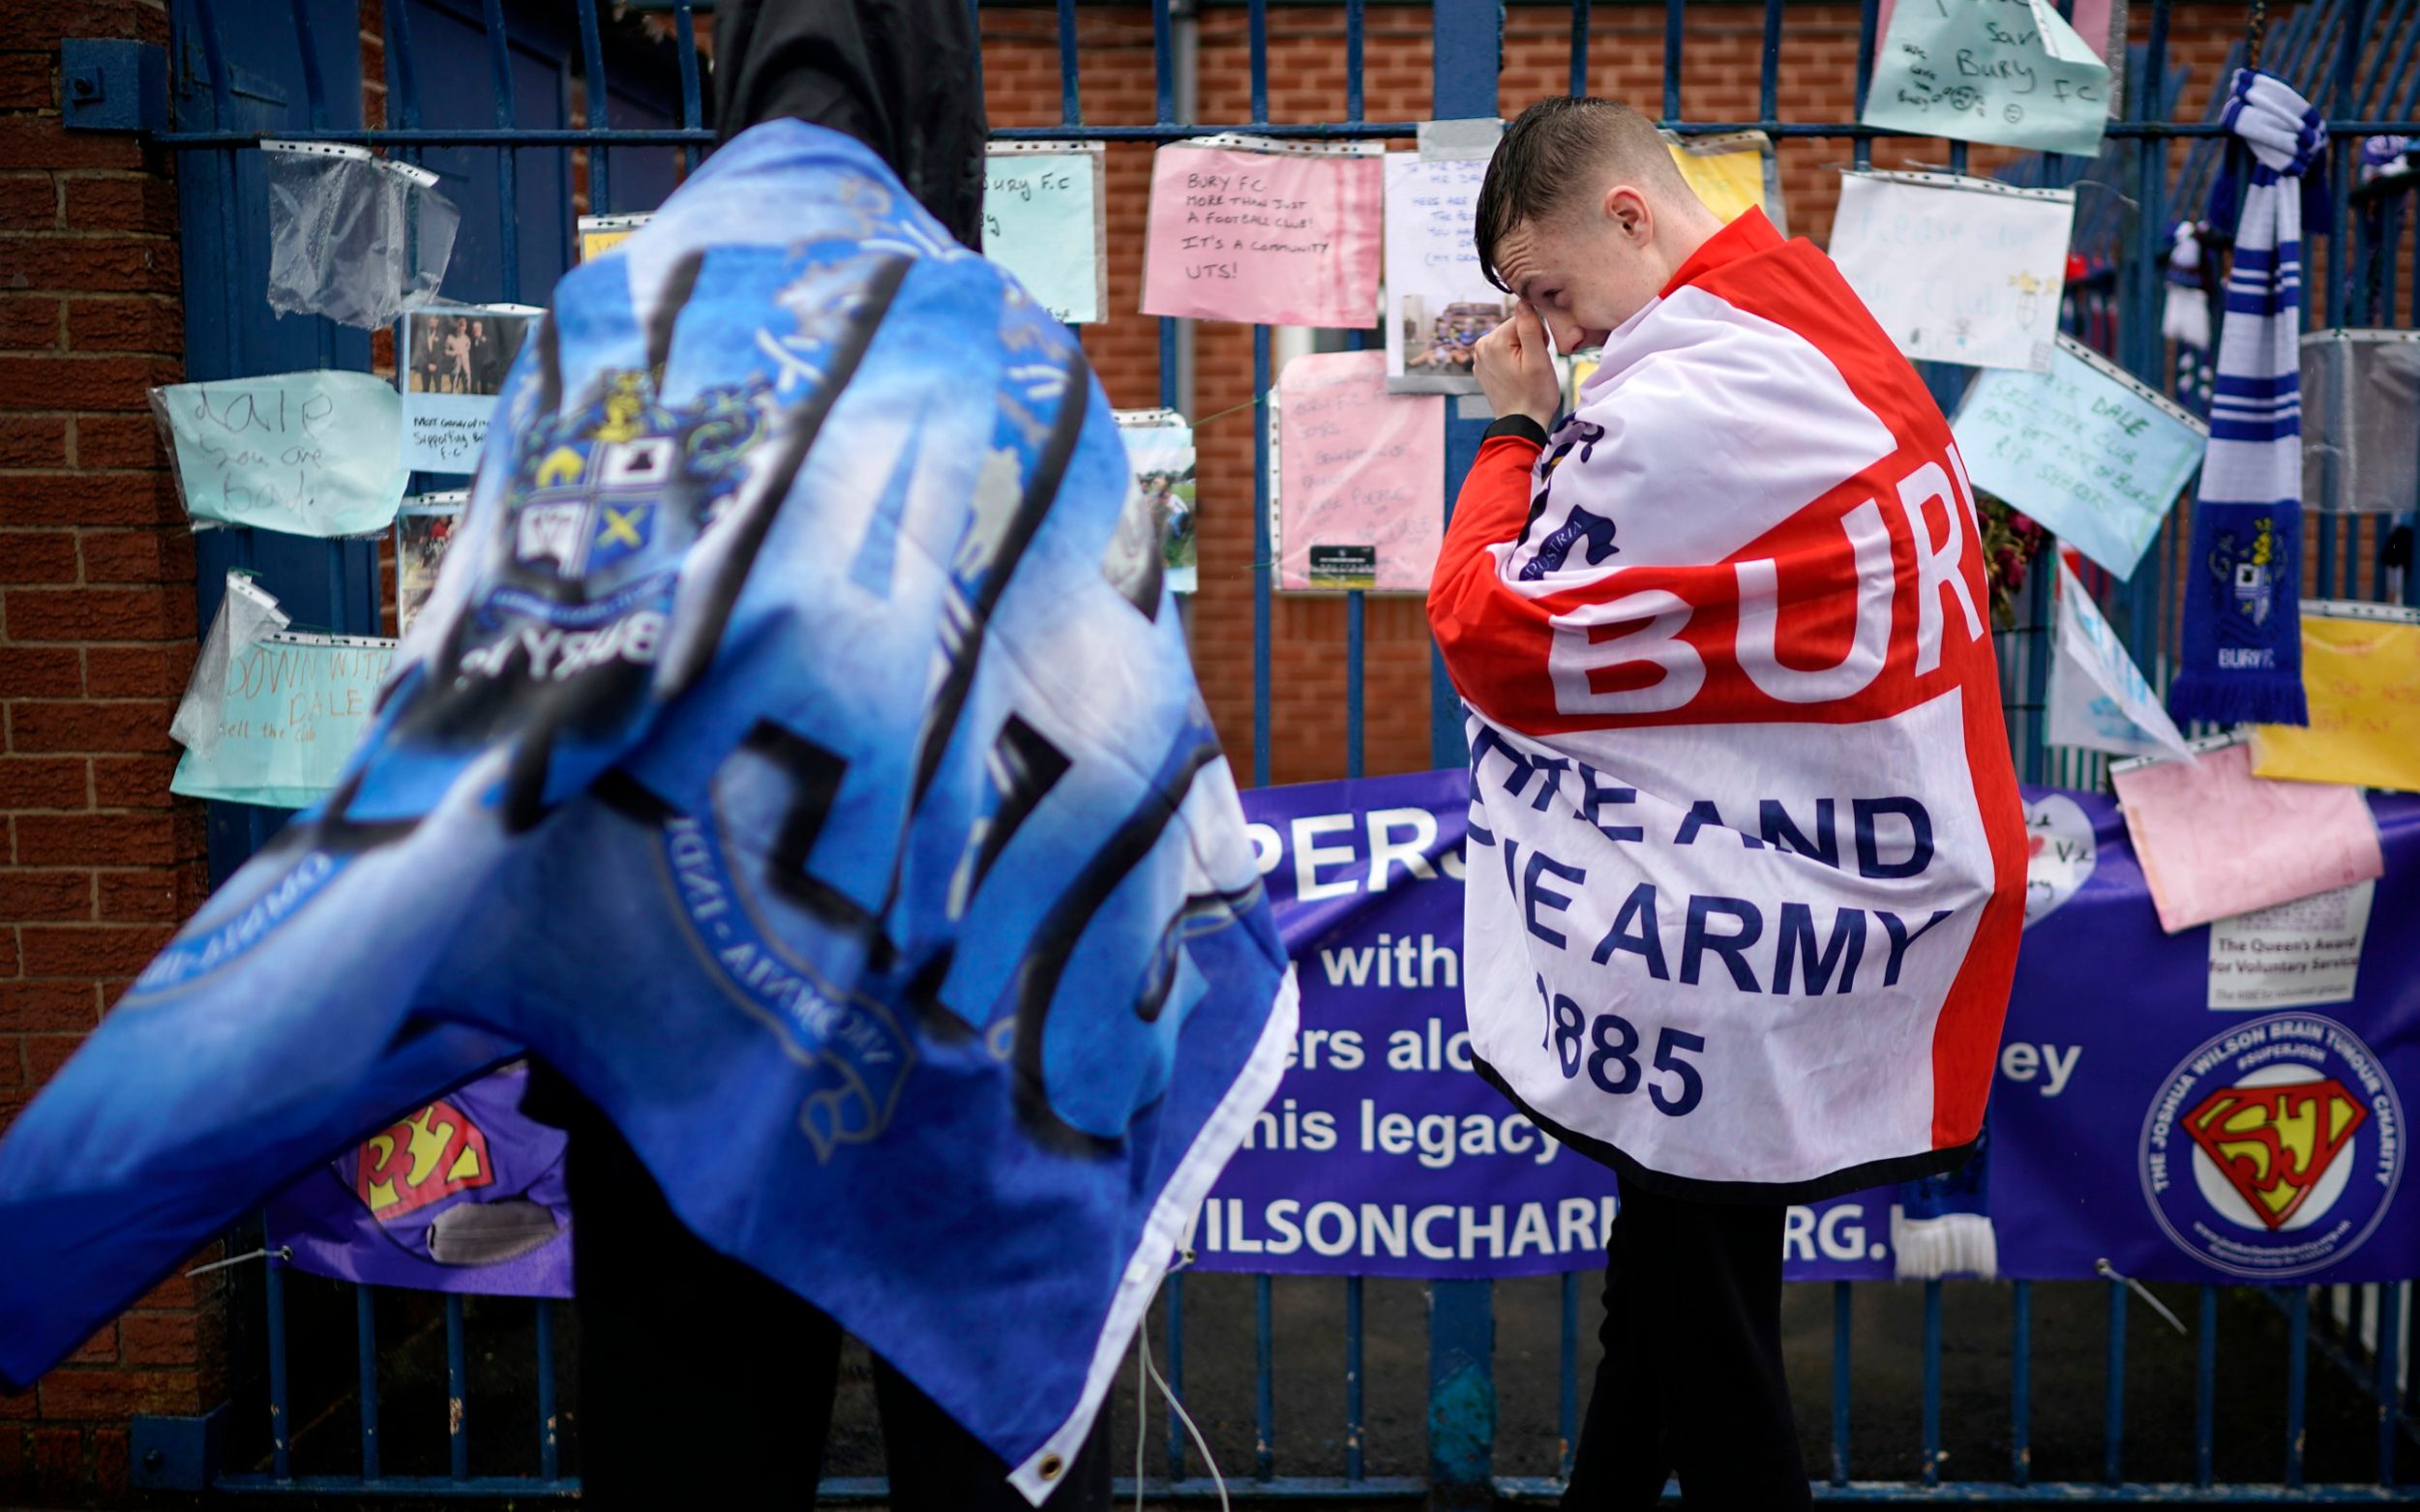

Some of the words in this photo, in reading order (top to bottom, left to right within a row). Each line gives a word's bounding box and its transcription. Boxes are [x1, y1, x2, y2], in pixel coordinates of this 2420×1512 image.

[1186, 173, 1231, 192] BURY
[1186, 195, 1224, 207] MORE
[1229, 196, 1268, 208] THAN
[1186, 212, 1199, 223] A
[1206, 212, 1270, 226] FOOTBALL
[1181, 235, 1224, 251] IT'S
[1234, 240, 1243, 251] A
[1186, 262, 1238, 280] UTS!
[2089, 395, 2150, 439] DALE
[1674, 796, 1935, 878] AND
[1592, 882, 1954, 995] ARMY
[2219, 937, 2246, 952] The
[2251, 937, 2310, 954] Queen's
[2315, 935, 2357, 950] Award
[1321, 934, 1457, 988] with
[2236, 959, 2307, 973] Voluntary
[2270, 1021, 2324, 1040] BRAIN
[2192, 1025, 2267, 1076] WILSON
[2151, 1075, 2196, 1148] JOSHUA
[2373, 1095, 2397, 1186] CHARITY
[2149, 1153, 2169, 1194] THE
